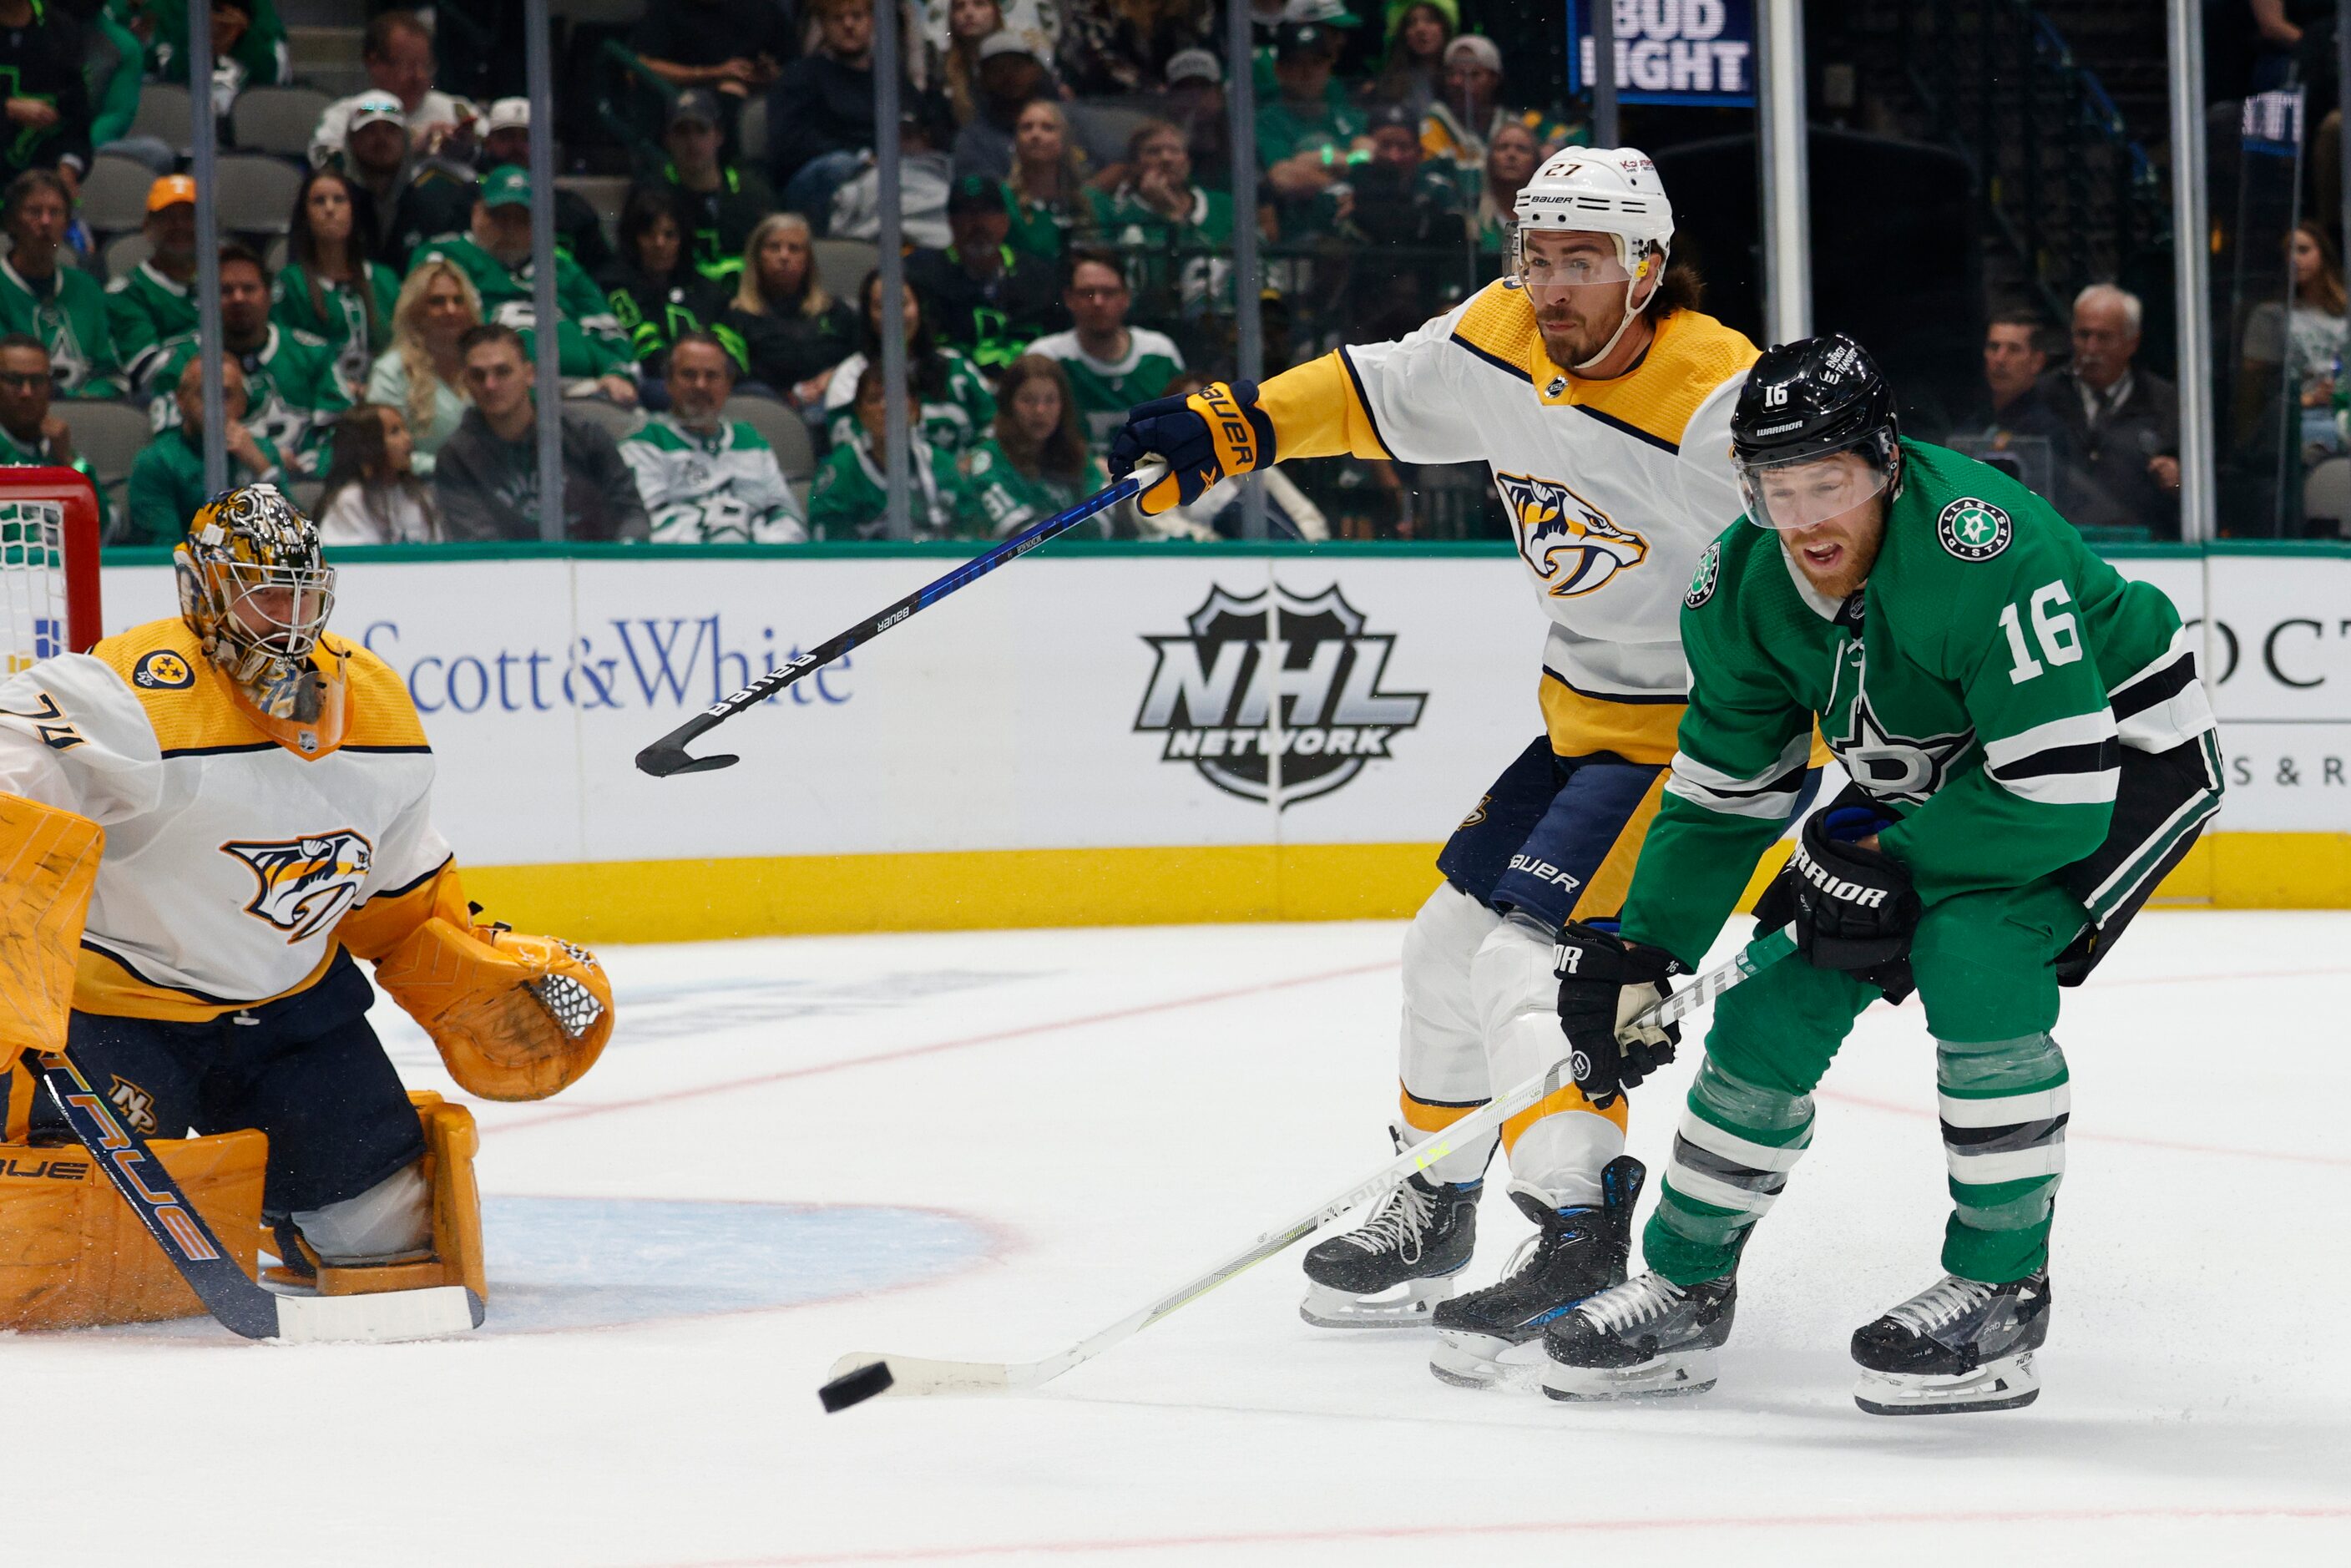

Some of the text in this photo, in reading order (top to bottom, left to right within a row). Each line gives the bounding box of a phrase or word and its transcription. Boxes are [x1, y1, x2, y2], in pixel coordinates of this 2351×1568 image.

[1544, 164, 1582, 178] 27
[1531, 195, 1573, 204] BAUER
[1825, 345, 1848, 368] ENERGY
[1765, 385, 1789, 407] 16
[1198, 386, 1254, 466] AUER
[1757, 420, 1803, 437] WARRIOR
[1942, 501, 1986, 549] DALLAS
[1971, 516, 2008, 557] STARS
[877, 606, 910, 633] BAUER
[1998, 579, 2083, 685] 16
[708, 653, 817, 716] BAUER
[1140, 640, 1422, 726] NHL
[1168, 729, 1386, 757] NETWORK
[2276, 756, 2300, 786] &
[1509, 854, 1580, 893] AUER
[1791, 842, 1888, 908] RRIOR
[1666, 960, 1679, 973] 16
[0, 1159, 89, 1180] UE
[38, 1050, 220, 1261] TRUE
[1984, 1321, 2000, 1336] PRO
